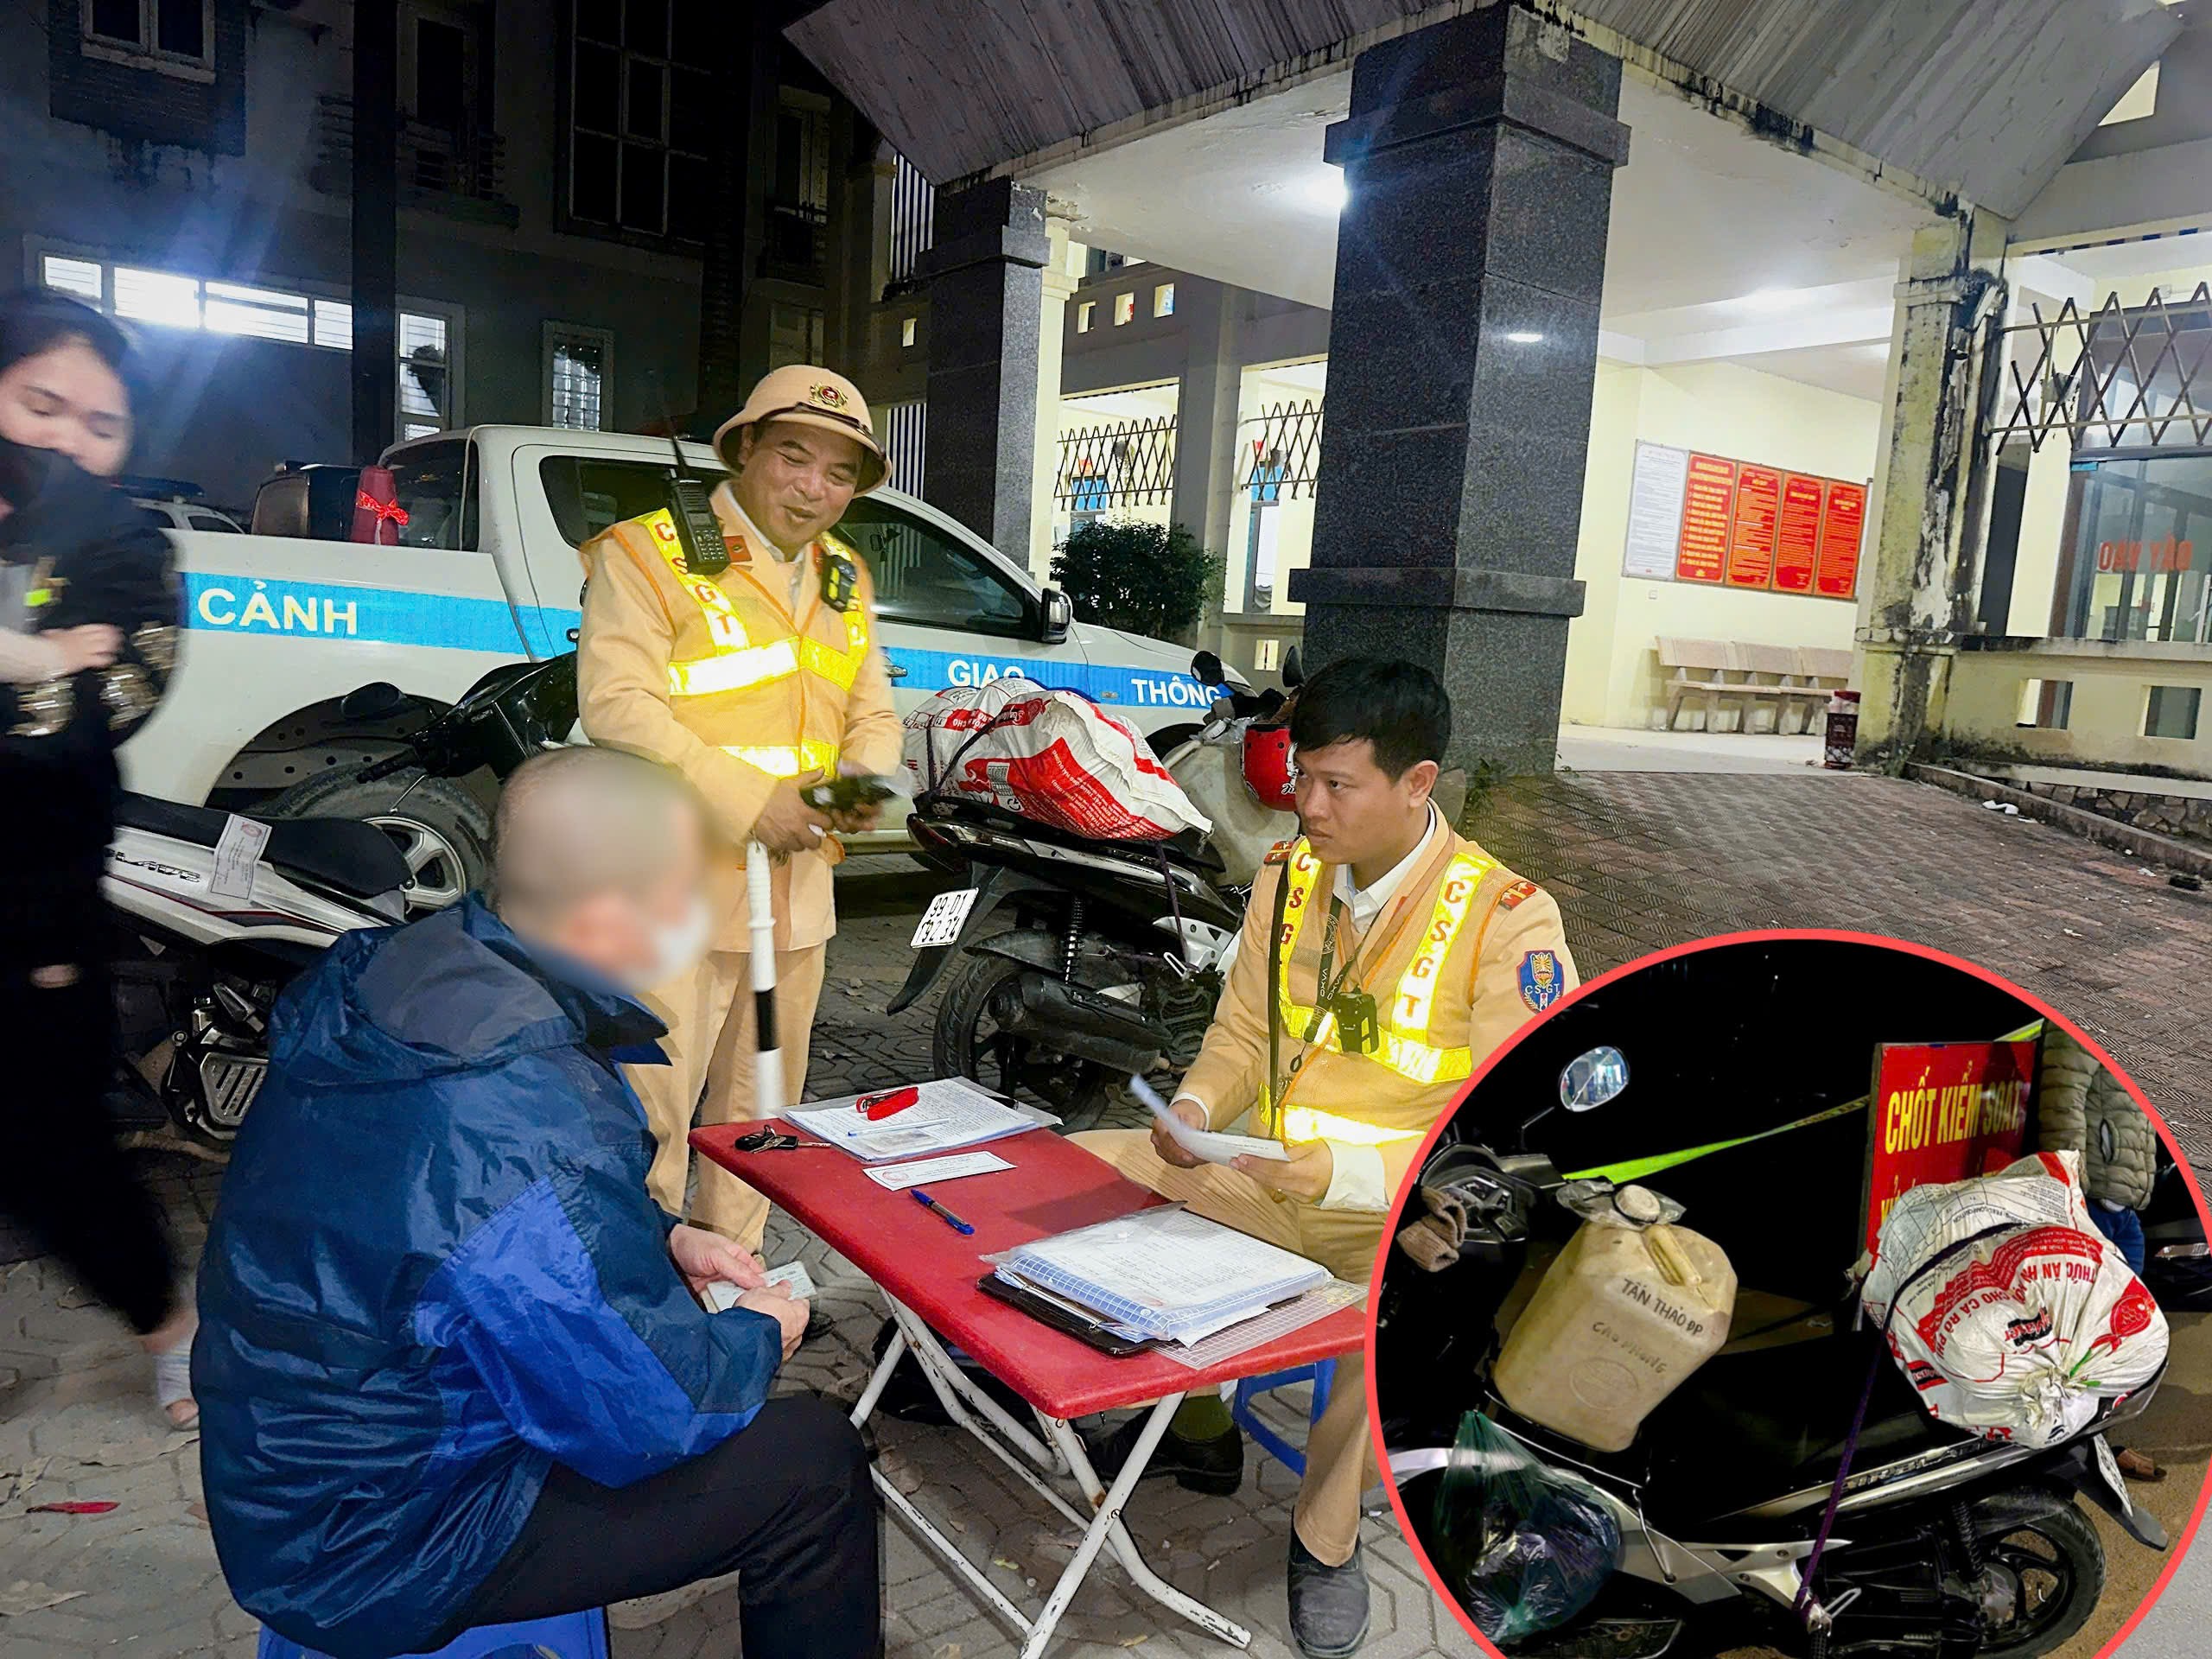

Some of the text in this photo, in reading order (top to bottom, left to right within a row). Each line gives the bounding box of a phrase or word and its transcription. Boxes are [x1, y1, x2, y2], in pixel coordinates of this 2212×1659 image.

[198, 580, 358, 635] CẢNH
[1524, 983, 1560, 995] CSGT
[1885, 1065, 1937, 1154] CHỐT
[1936, 1060, 1984, 1145] KIỂM
[2043, 1262, 2062, 1284] ĂN
[2065, 1261, 2095, 1286] THỨC
[1982, 1288, 2009, 1304] CHO
[1960, 1300, 1980, 1318] CÁ
